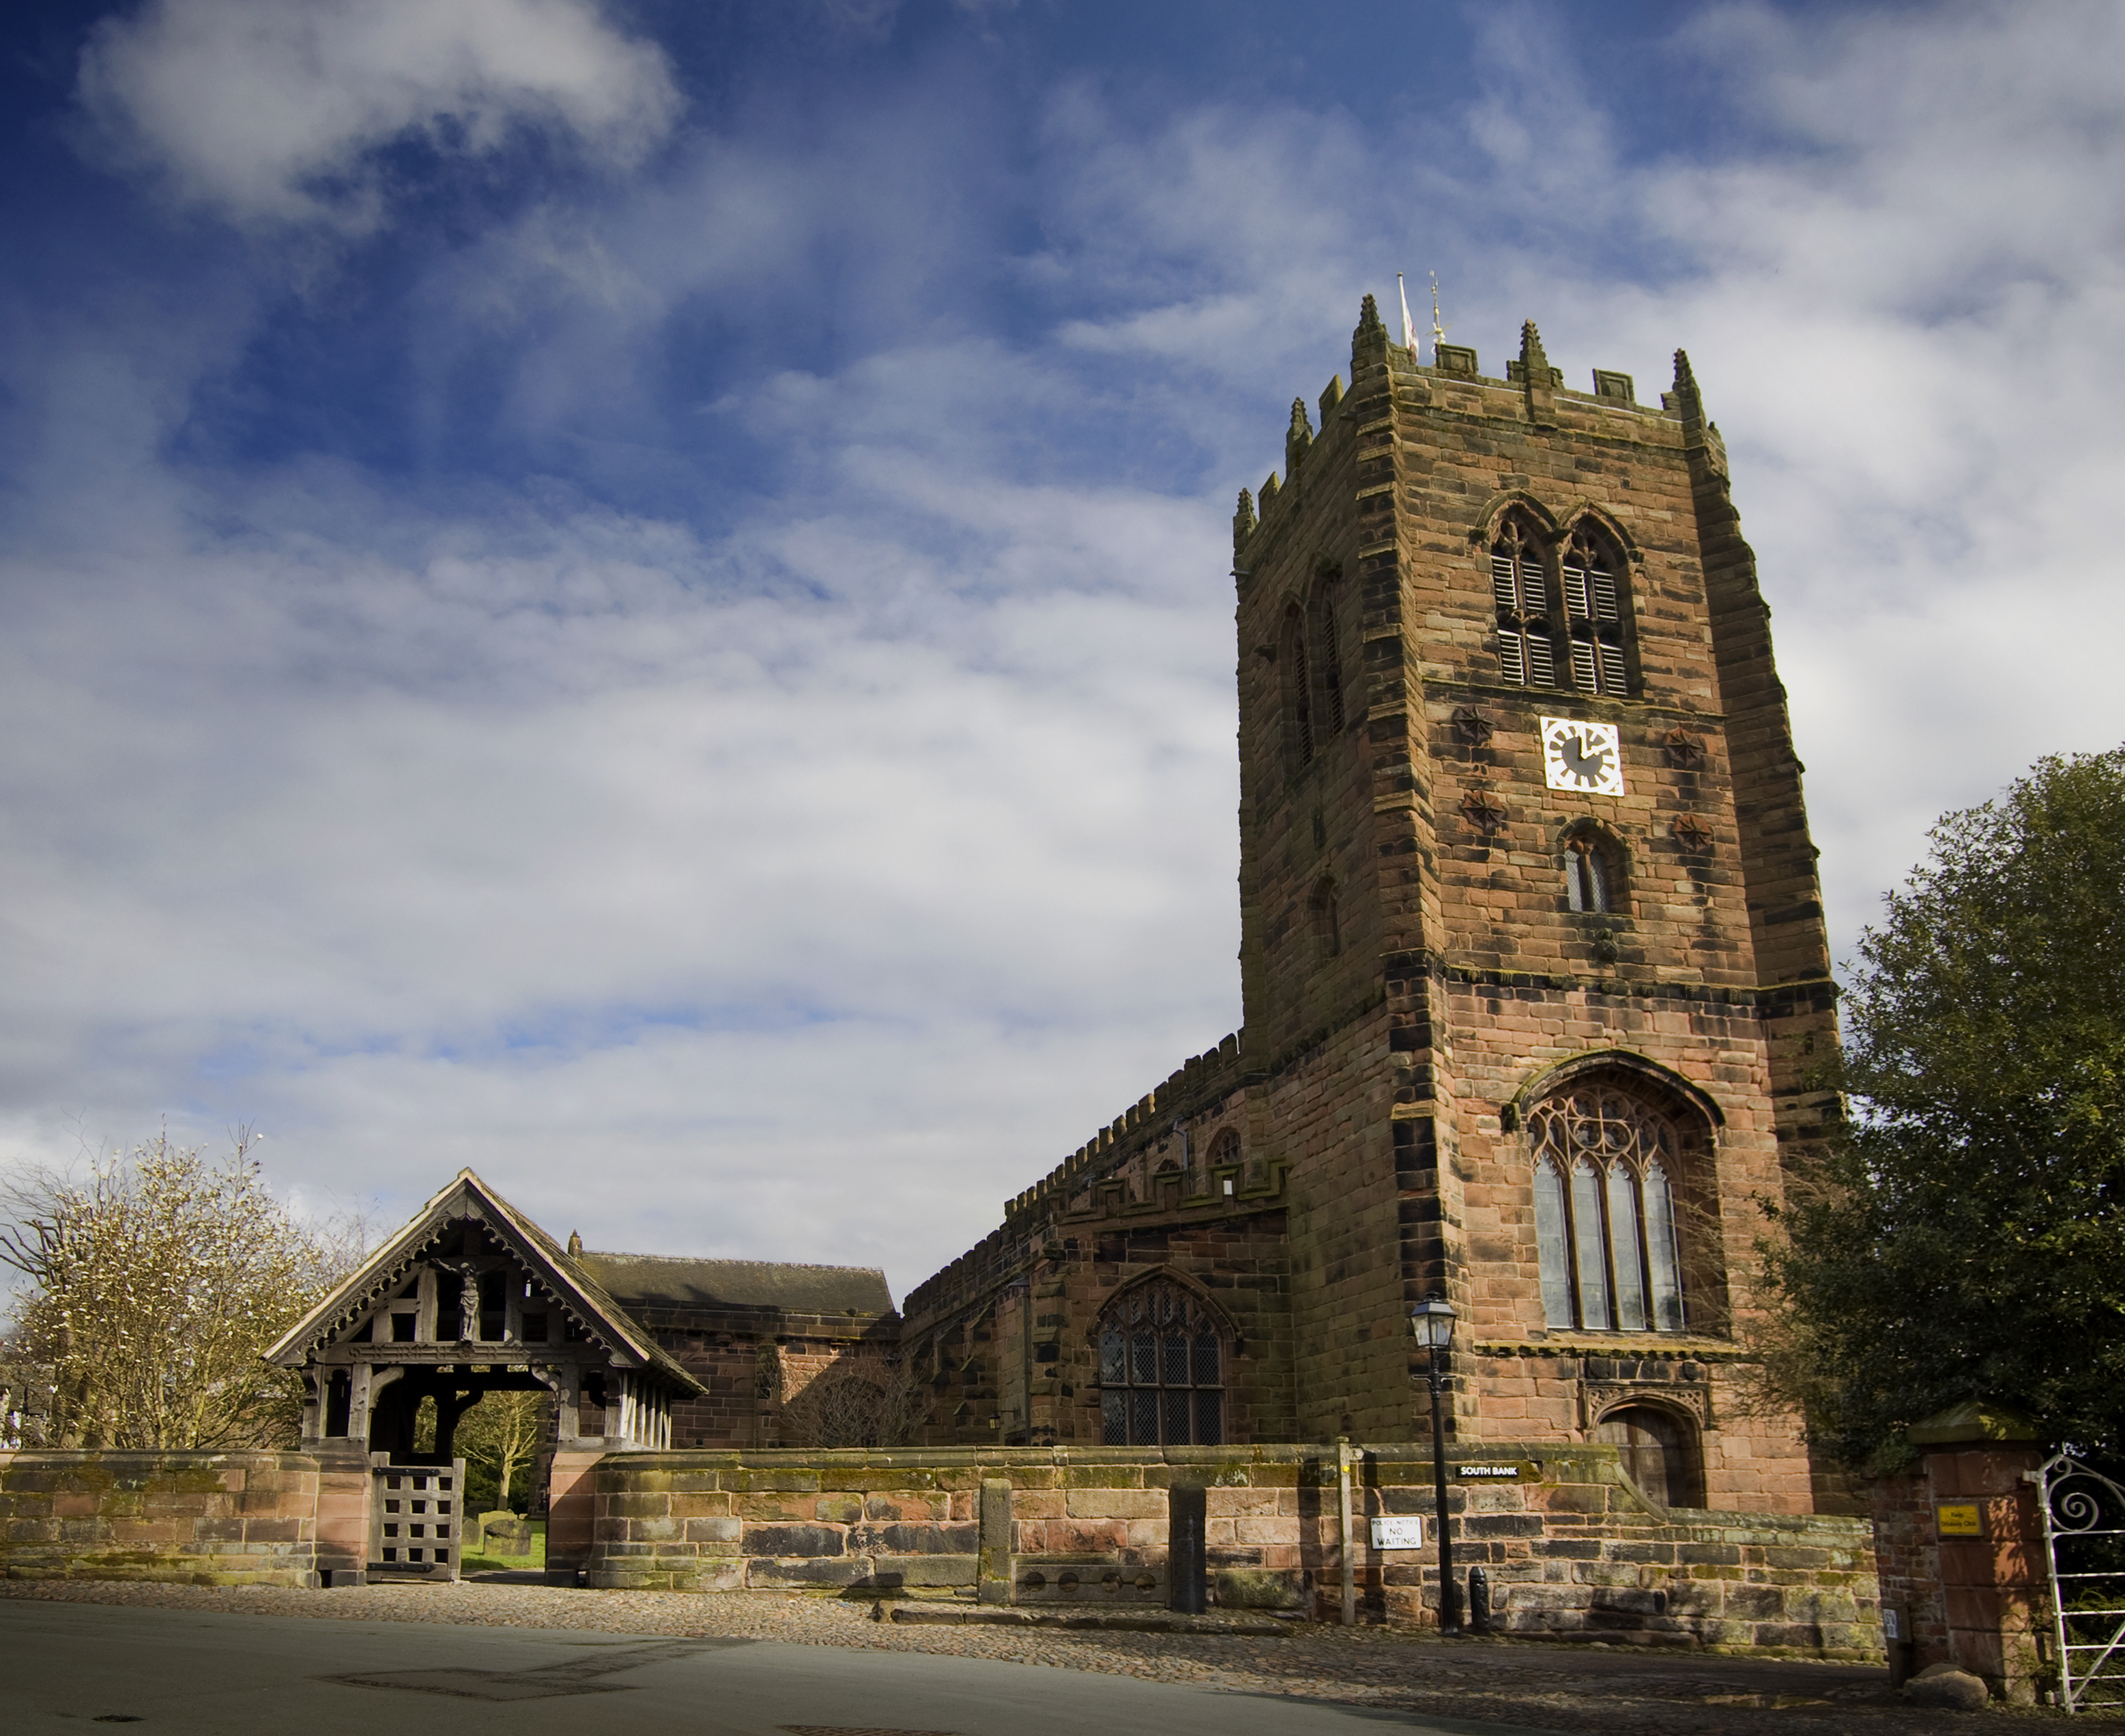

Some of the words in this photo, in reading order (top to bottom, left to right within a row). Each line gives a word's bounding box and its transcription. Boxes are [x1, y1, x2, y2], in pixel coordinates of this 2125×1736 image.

[1460, 1466, 1491, 1475] SOUTH
[1492, 1466, 1518, 1475] BANK
[1389, 1527, 1403, 1535] NO
[1377, 1537, 1416, 1546] WAITING
